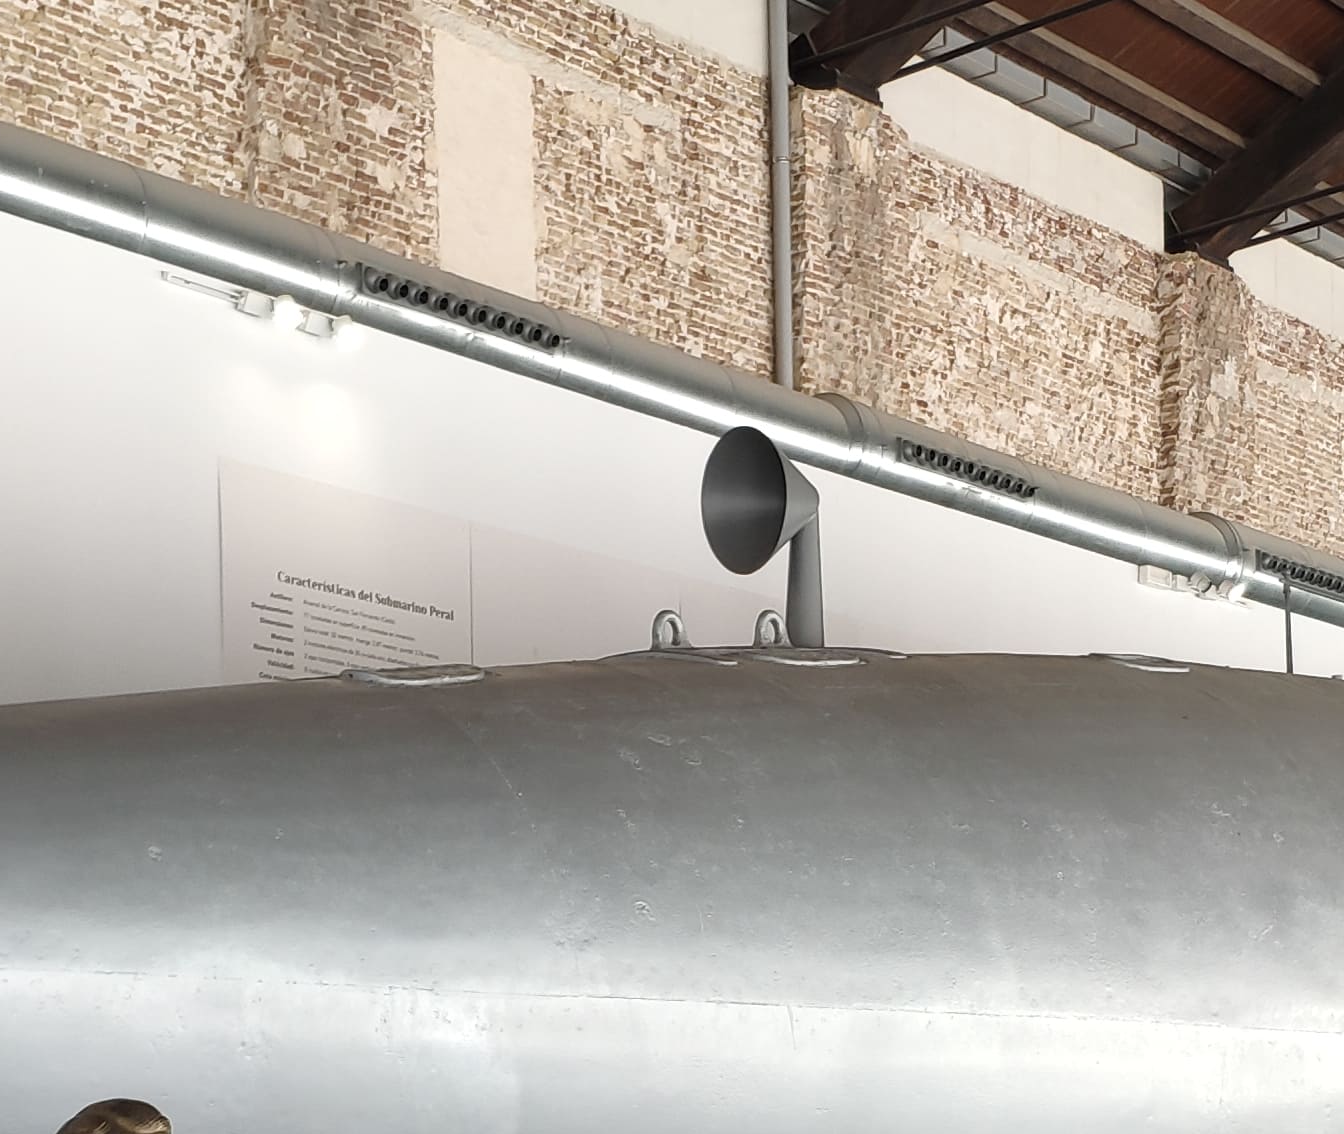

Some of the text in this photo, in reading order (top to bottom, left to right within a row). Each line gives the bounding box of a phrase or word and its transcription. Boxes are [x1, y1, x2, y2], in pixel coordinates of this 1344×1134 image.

[358, 589, 372, 602] del
[375, 592, 427, 615] Submarino
[429, 605, 454, 621] Peral
